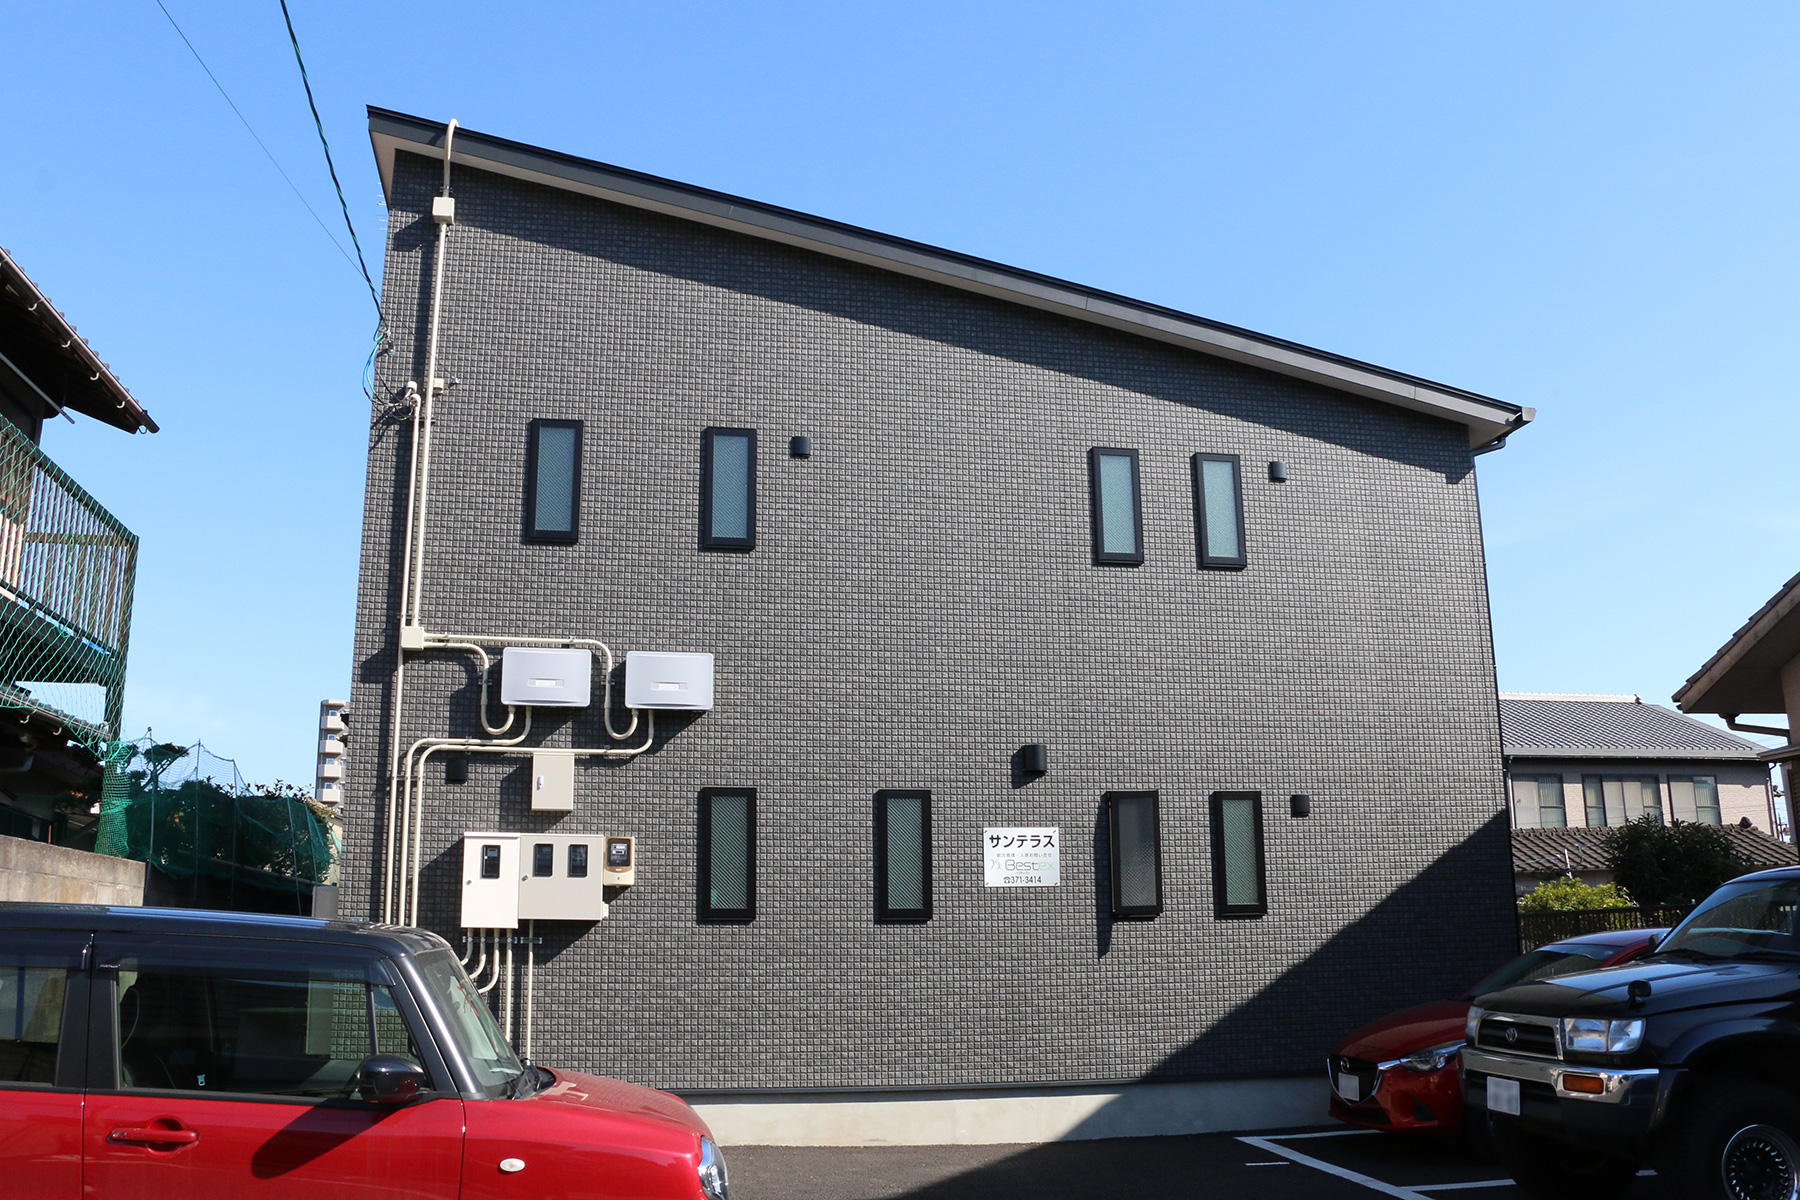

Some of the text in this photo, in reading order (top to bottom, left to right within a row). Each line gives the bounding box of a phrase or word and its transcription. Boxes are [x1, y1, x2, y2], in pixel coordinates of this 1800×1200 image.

[989, 835, 1055, 848] サンテラス
